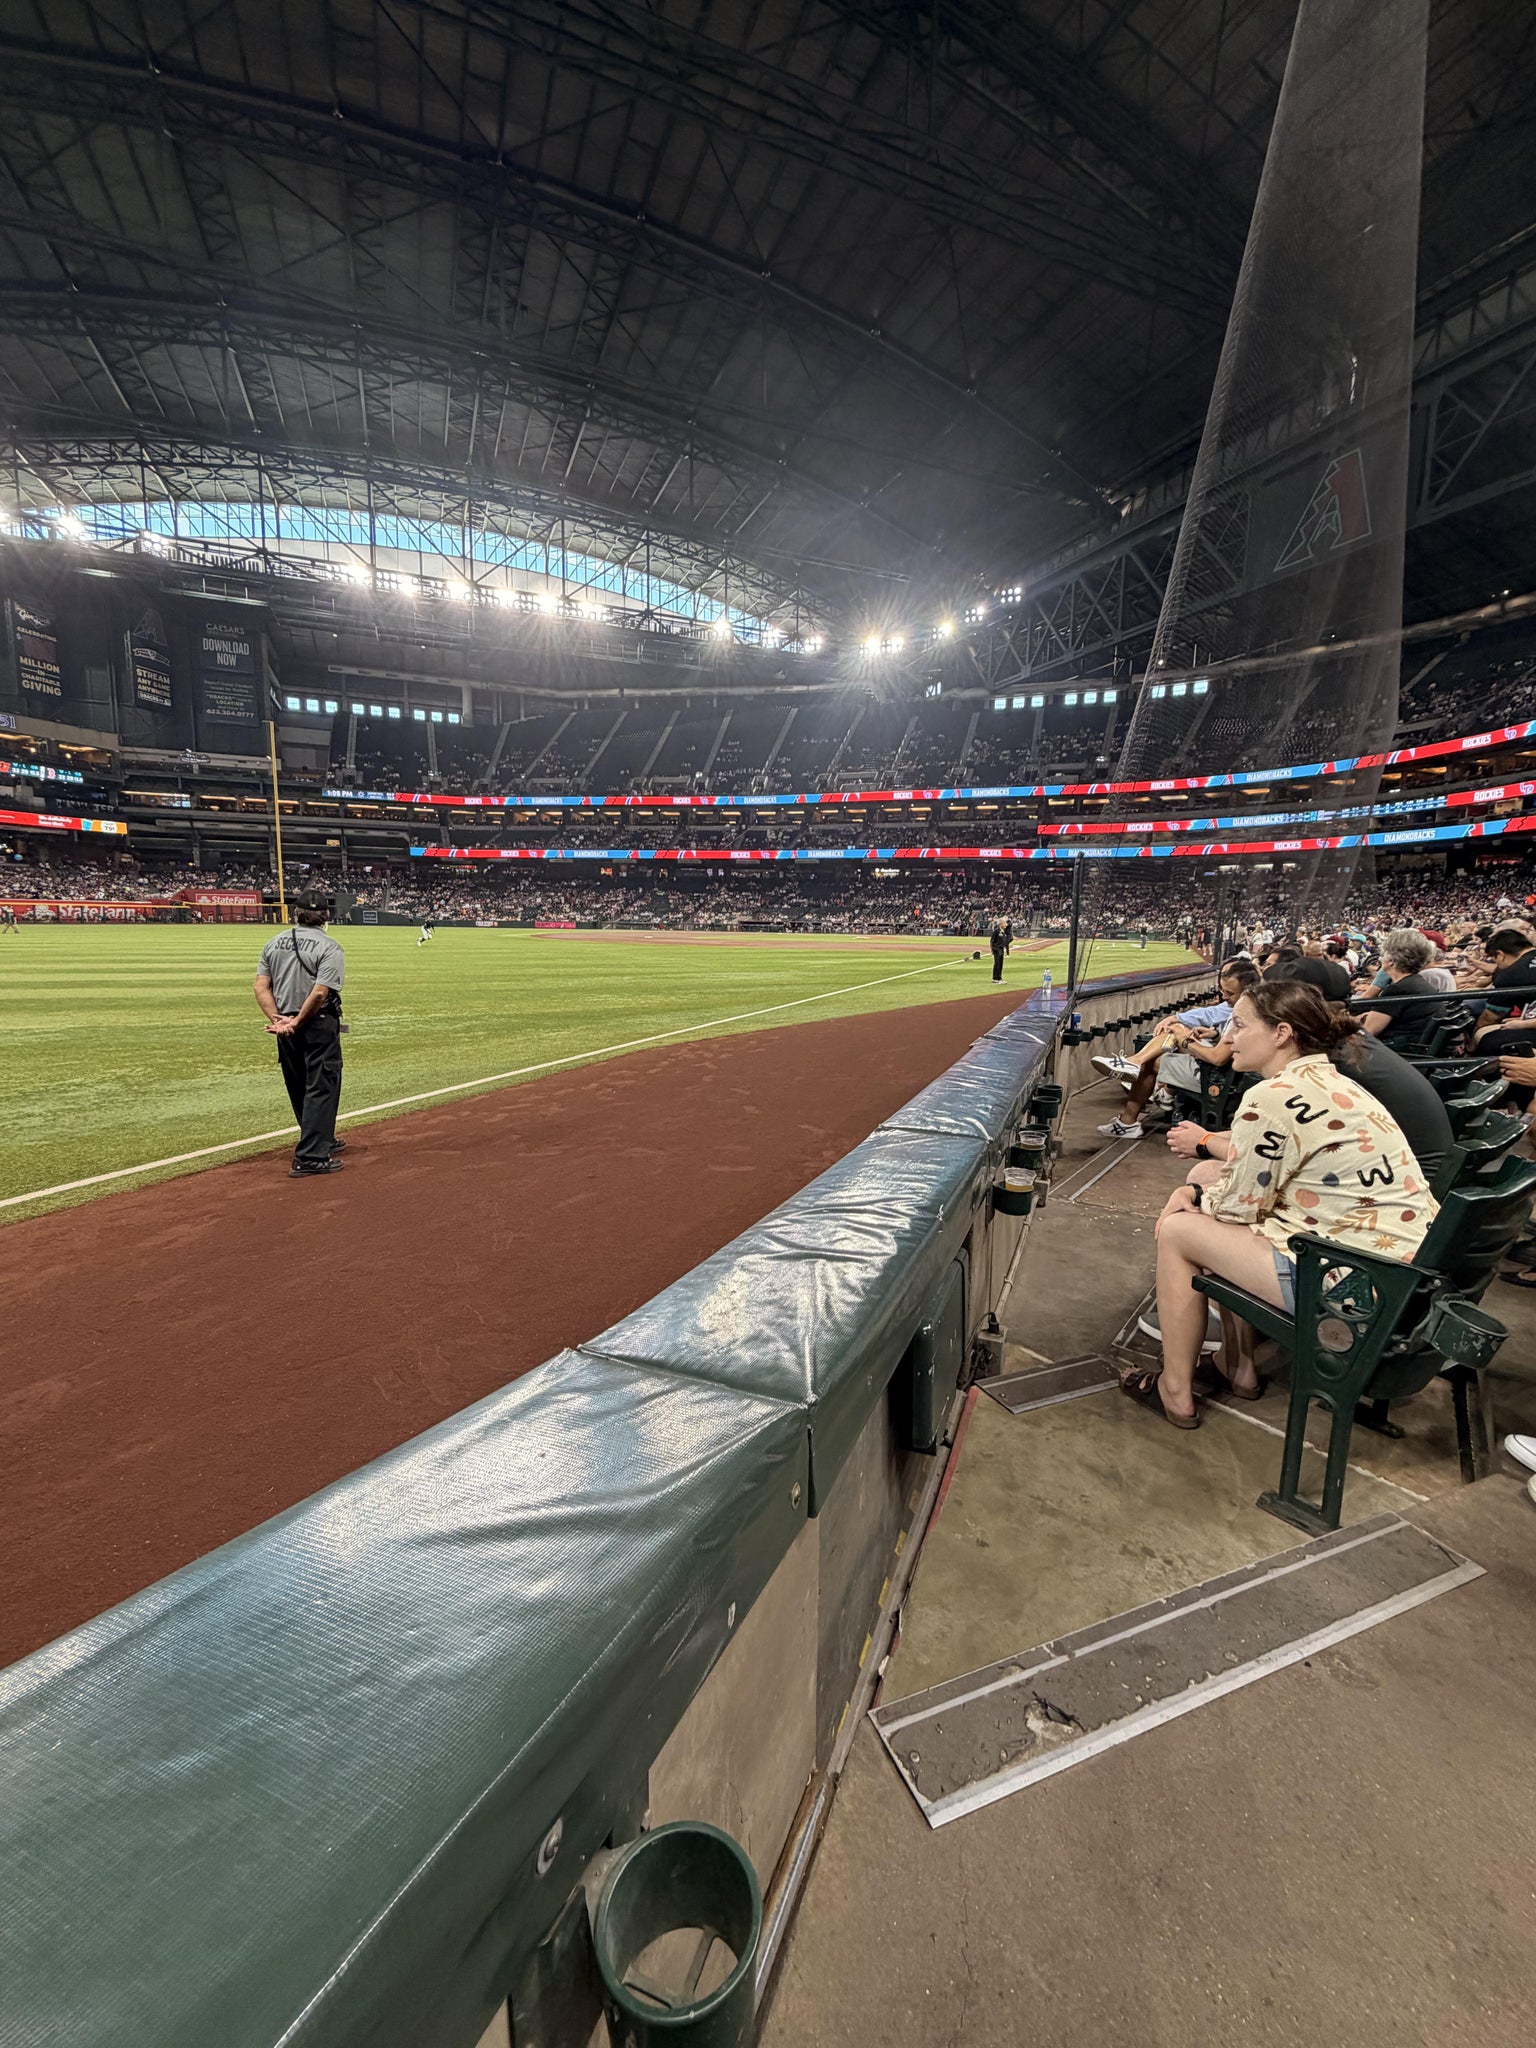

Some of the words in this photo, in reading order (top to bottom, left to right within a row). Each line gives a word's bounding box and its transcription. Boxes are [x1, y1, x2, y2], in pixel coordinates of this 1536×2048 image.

[202, 637, 250, 655] DOWNLOAD
[20, 656, 60, 673] MILLION
[216, 652, 237, 667] NOW
[136, 668, 170, 684] STREAM
[137, 677, 151, 686] ANY
[22, 679, 62, 696] GIVING
[1462, 734, 1492, 748] ROCKIES
[1150, 781, 1175, 790] ROCKIES
[1246, 769, 1292, 781] DIAMONDBACKS
[1473, 788, 1505, 802] ROCKIES
[1126, 822, 1153, 832] ROCKIES
[1232, 814, 1284, 827] DIAMONDBACKS
[1273, 841, 1302, 850] ROCKIES
[1384, 830, 1436, 843] DIAMONDBACKS
